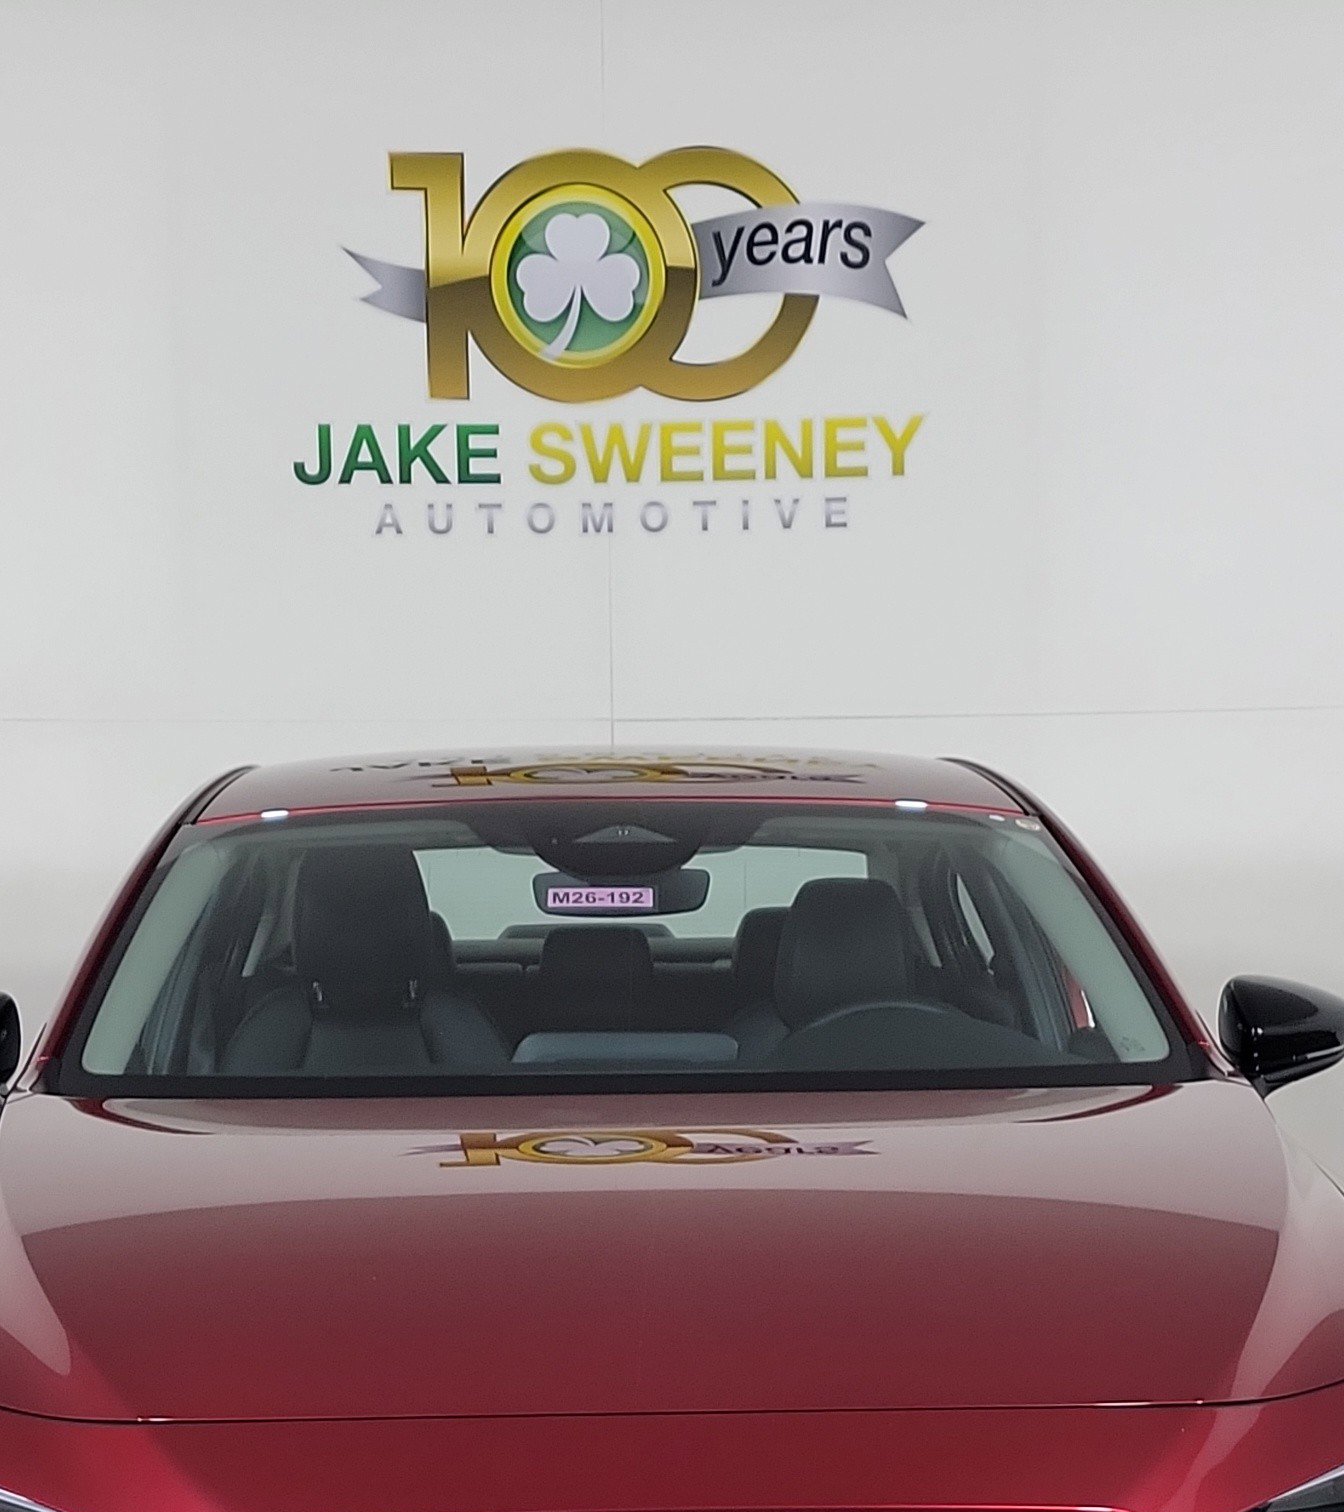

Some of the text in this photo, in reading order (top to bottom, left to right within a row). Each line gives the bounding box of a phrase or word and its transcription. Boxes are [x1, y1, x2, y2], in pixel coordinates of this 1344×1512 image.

[387, 145, 874, 403] 100 years
[293, 415, 924, 487] JAKE SWEENEY
[375, 497, 849, 535] AUTOMOTIVE
[552, 892, 645, 904] M26-192
